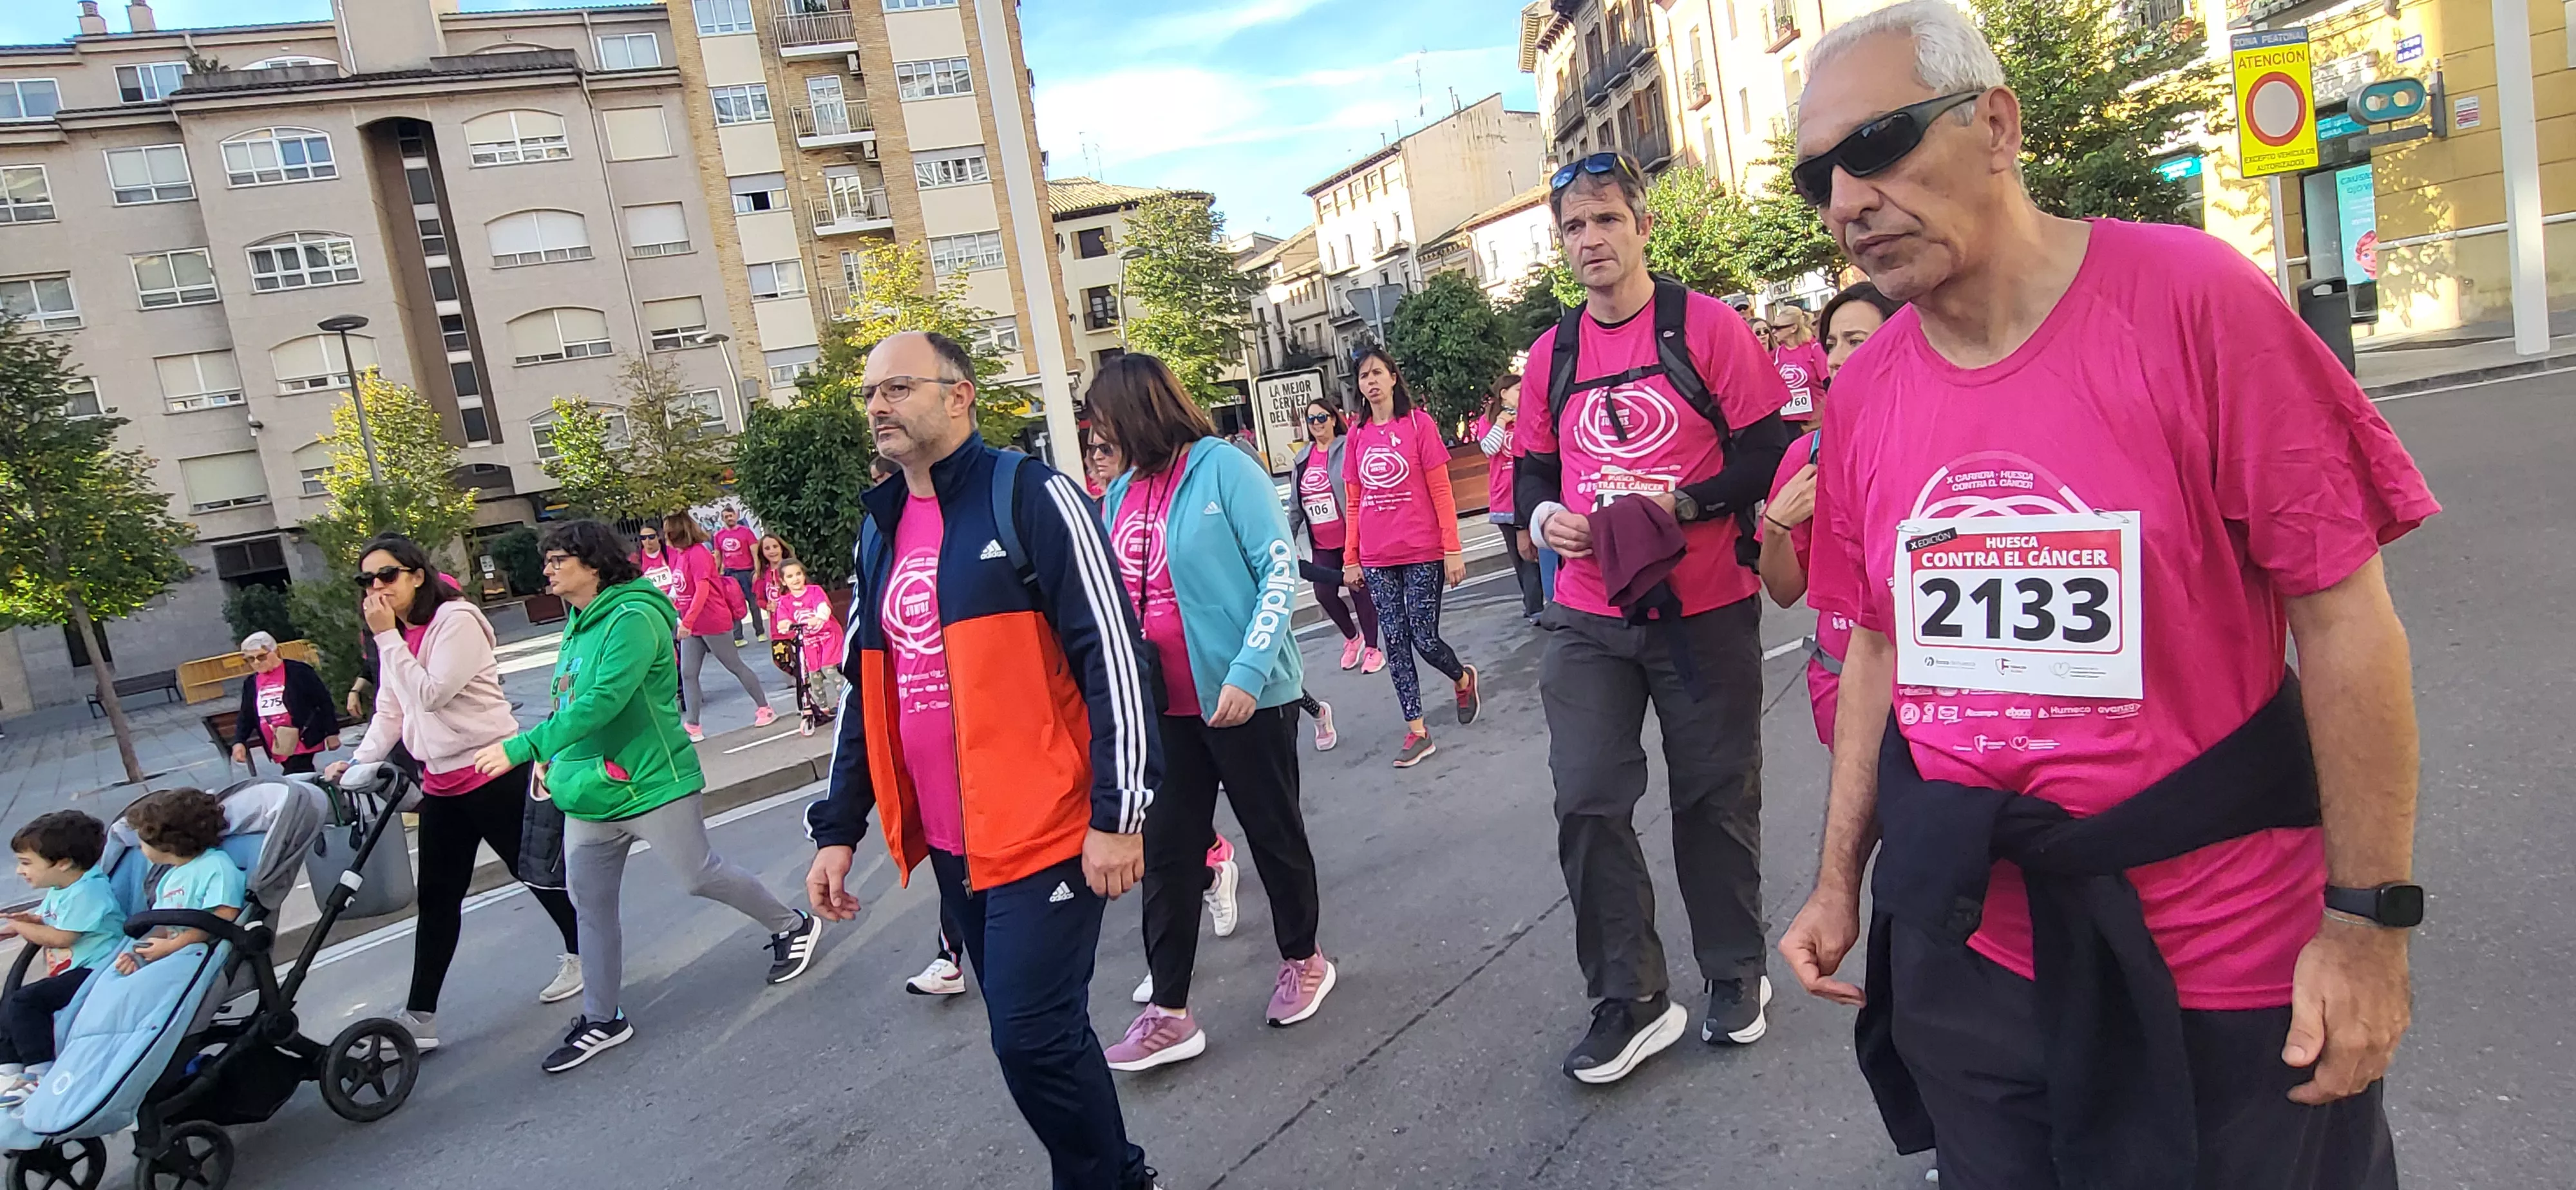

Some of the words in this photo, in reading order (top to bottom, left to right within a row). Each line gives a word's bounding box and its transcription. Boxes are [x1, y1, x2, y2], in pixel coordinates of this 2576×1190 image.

[2233, 37, 2258, 47] ZONA
[2262, 31, 2306, 44] PEATONAL
[2238, 48, 2305, 70] ATENCIÓN
[1269, 384, 1280, 397] LA
[1282, 380, 1312, 395] MEJOR
[1273, 393, 1312, 410] CERVEZA
[1269, 410, 1287, 423] DEL
[1629, 480, 1664, 491] CÁNCER
[1946, 475, 1953, 484] X
[1955, 471, 1994, 482] CARRERA
[2000, 471, 2034, 480] HUESCA
[1951, 480, 1987, 491] CONTRA
[1309, 504, 1329, 516] 106
[1917, 532, 1951, 548] EDICIÓN
[1985, 536, 2038, 549] HUESCA
[1921, 551, 2000, 567] CONTRA
[2005, 551, 2023, 567] EL
[2027, 547, 2109, 567] CÁNCER
[1247, 538, 1296, 650] adidas
[1919, 577, 2112, 643] 2133
